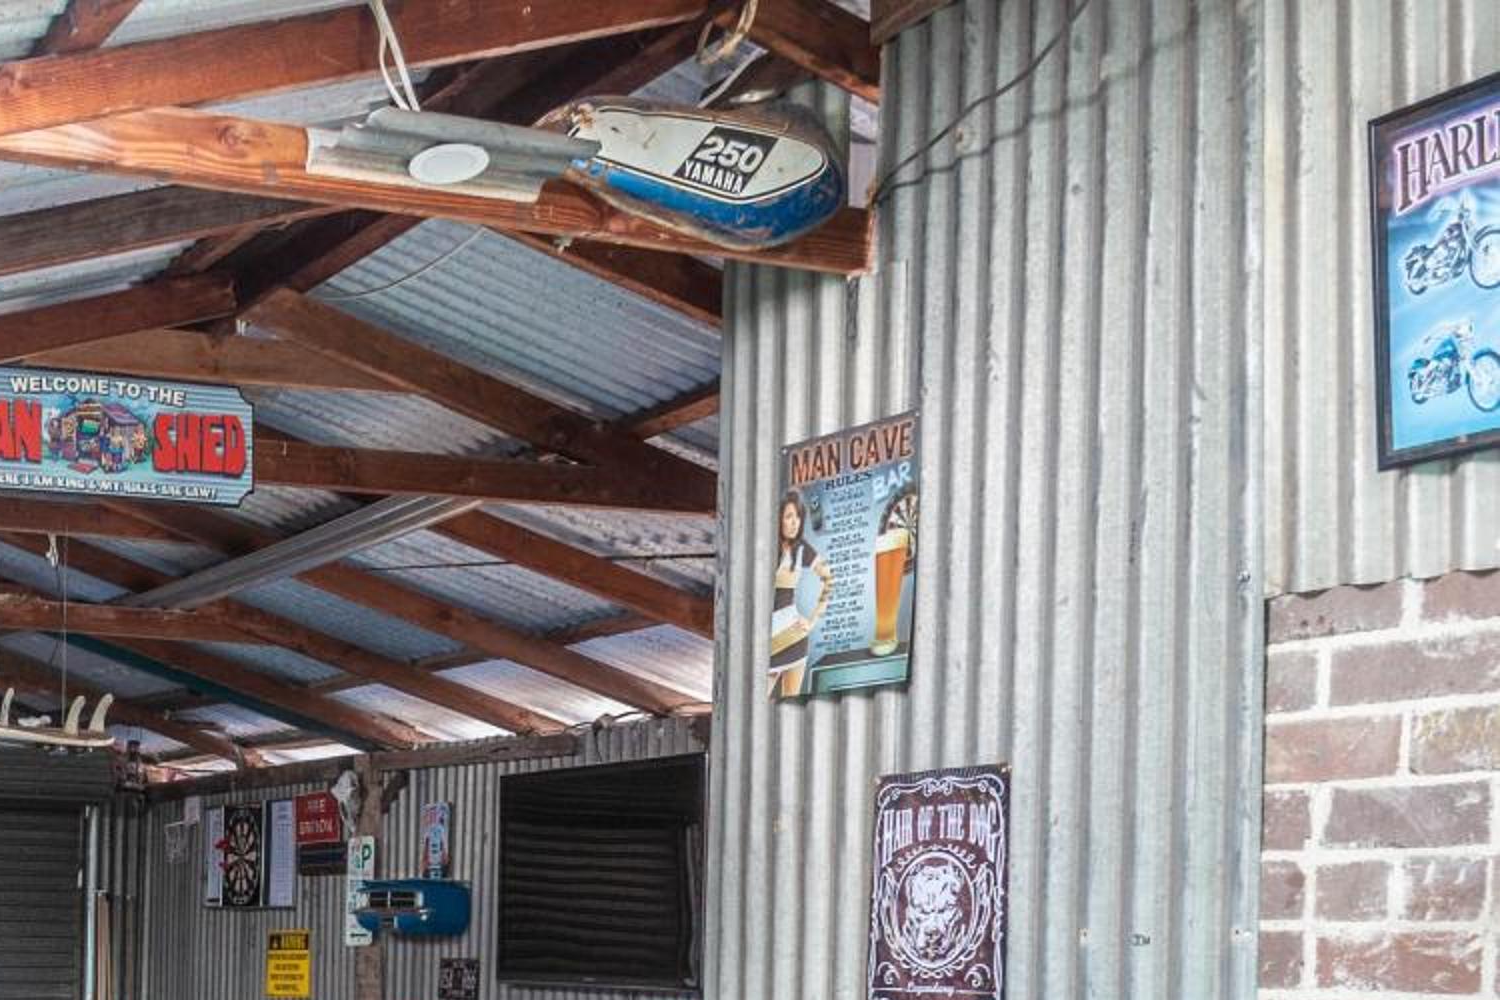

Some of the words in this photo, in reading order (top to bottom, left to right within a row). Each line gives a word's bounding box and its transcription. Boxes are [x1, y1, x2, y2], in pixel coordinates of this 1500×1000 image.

[694, 135, 765, 174] 250
[684, 160, 744, 193] YAMAHA
[9, 376, 109, 395] WELCOME
[115, 381, 141, 397] TO
[147, 387, 186, 406] THE
[151, 412, 246, 477] SHED
[791, 441, 841, 485] MAN
[850, 421, 913, 470] CAVE
[825, 472, 872, 490] RULES
[872, 462, 912, 501] BAR
[882, 808, 913, 868] HAIR
[917, 805, 934, 842] OF
[937, 803, 965, 840] THE
[968, 800, 1000, 863] DOG
